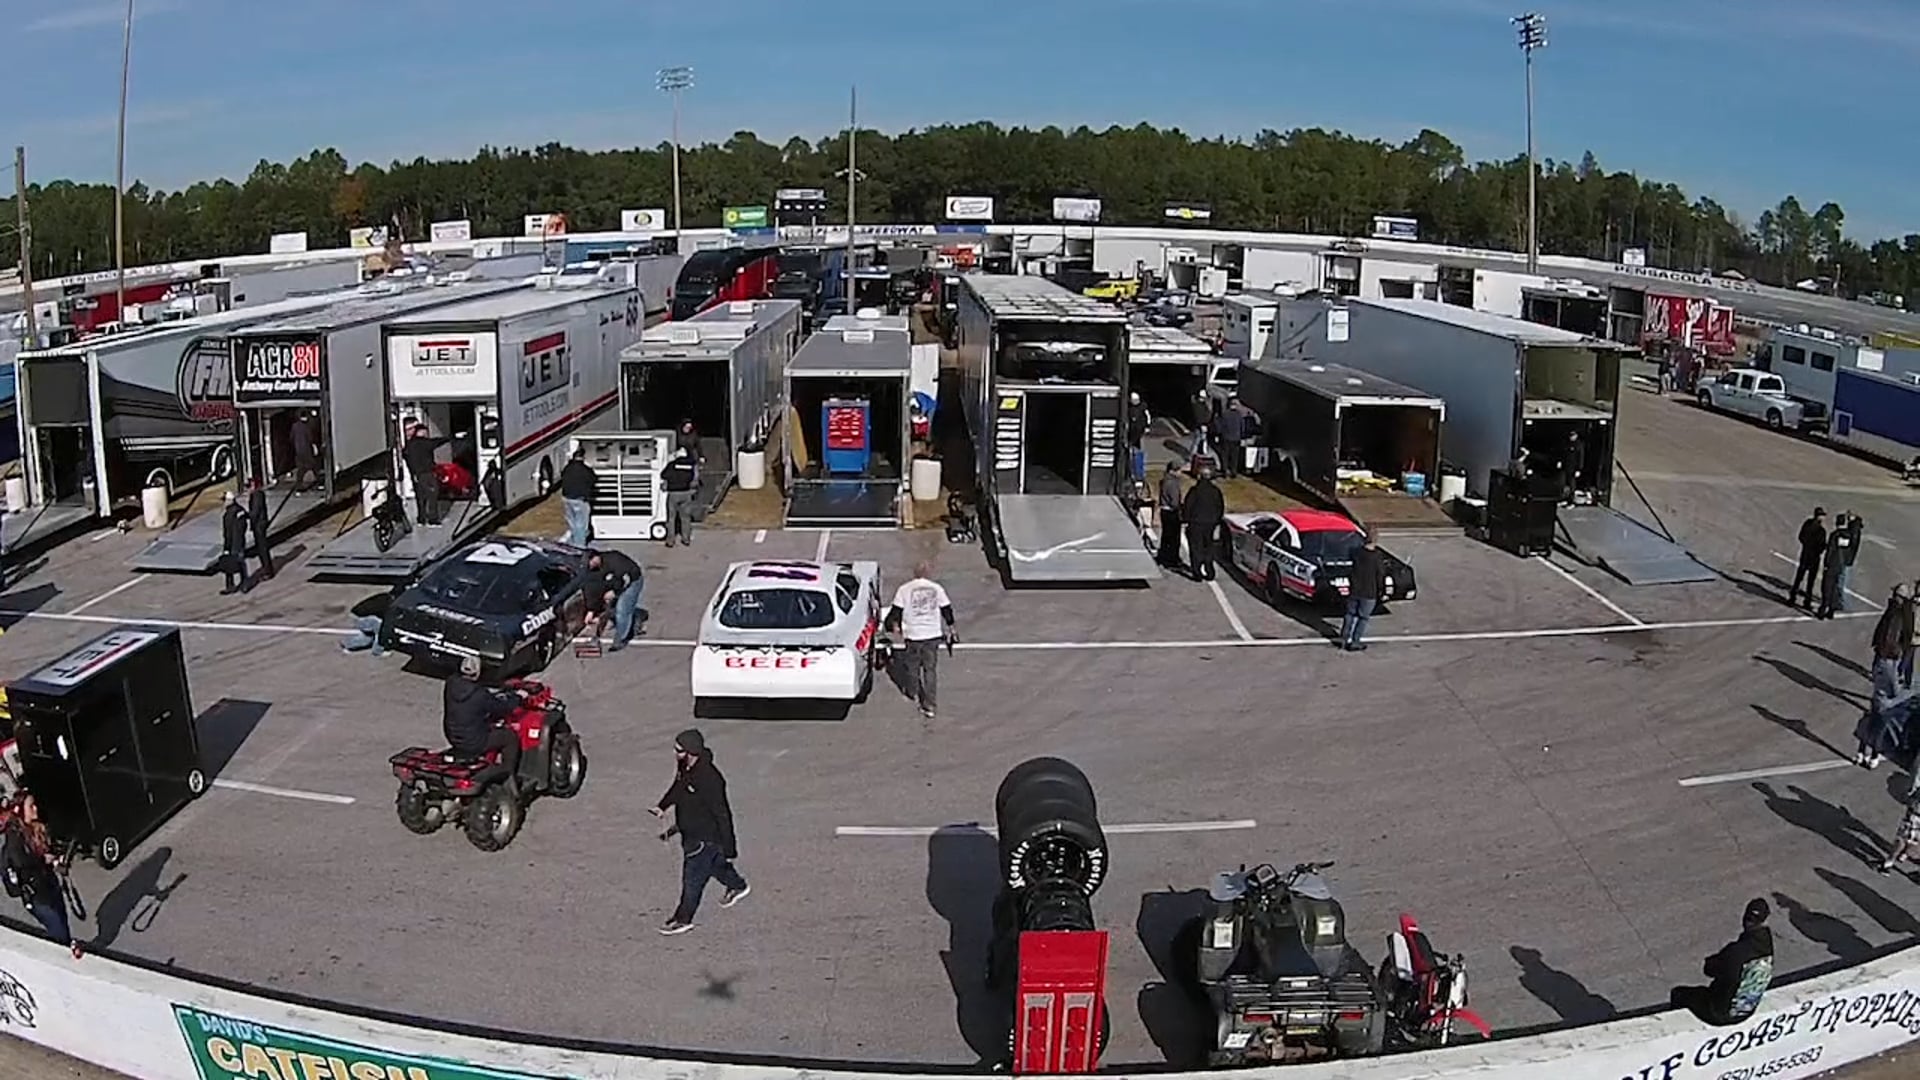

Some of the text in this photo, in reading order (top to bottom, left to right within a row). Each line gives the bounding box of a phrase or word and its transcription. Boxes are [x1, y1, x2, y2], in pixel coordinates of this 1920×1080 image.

[1614, 264, 1713, 286] PENSACOLA
[247, 342, 320, 379] ACR81
[419, 347, 470, 361] JET
[522, 346, 567, 389] JET
[725, 656, 820, 669] BEEF
[198, 1011, 269, 1044] DAVID'S
[1693, 1000, 1815, 1067] COAST
